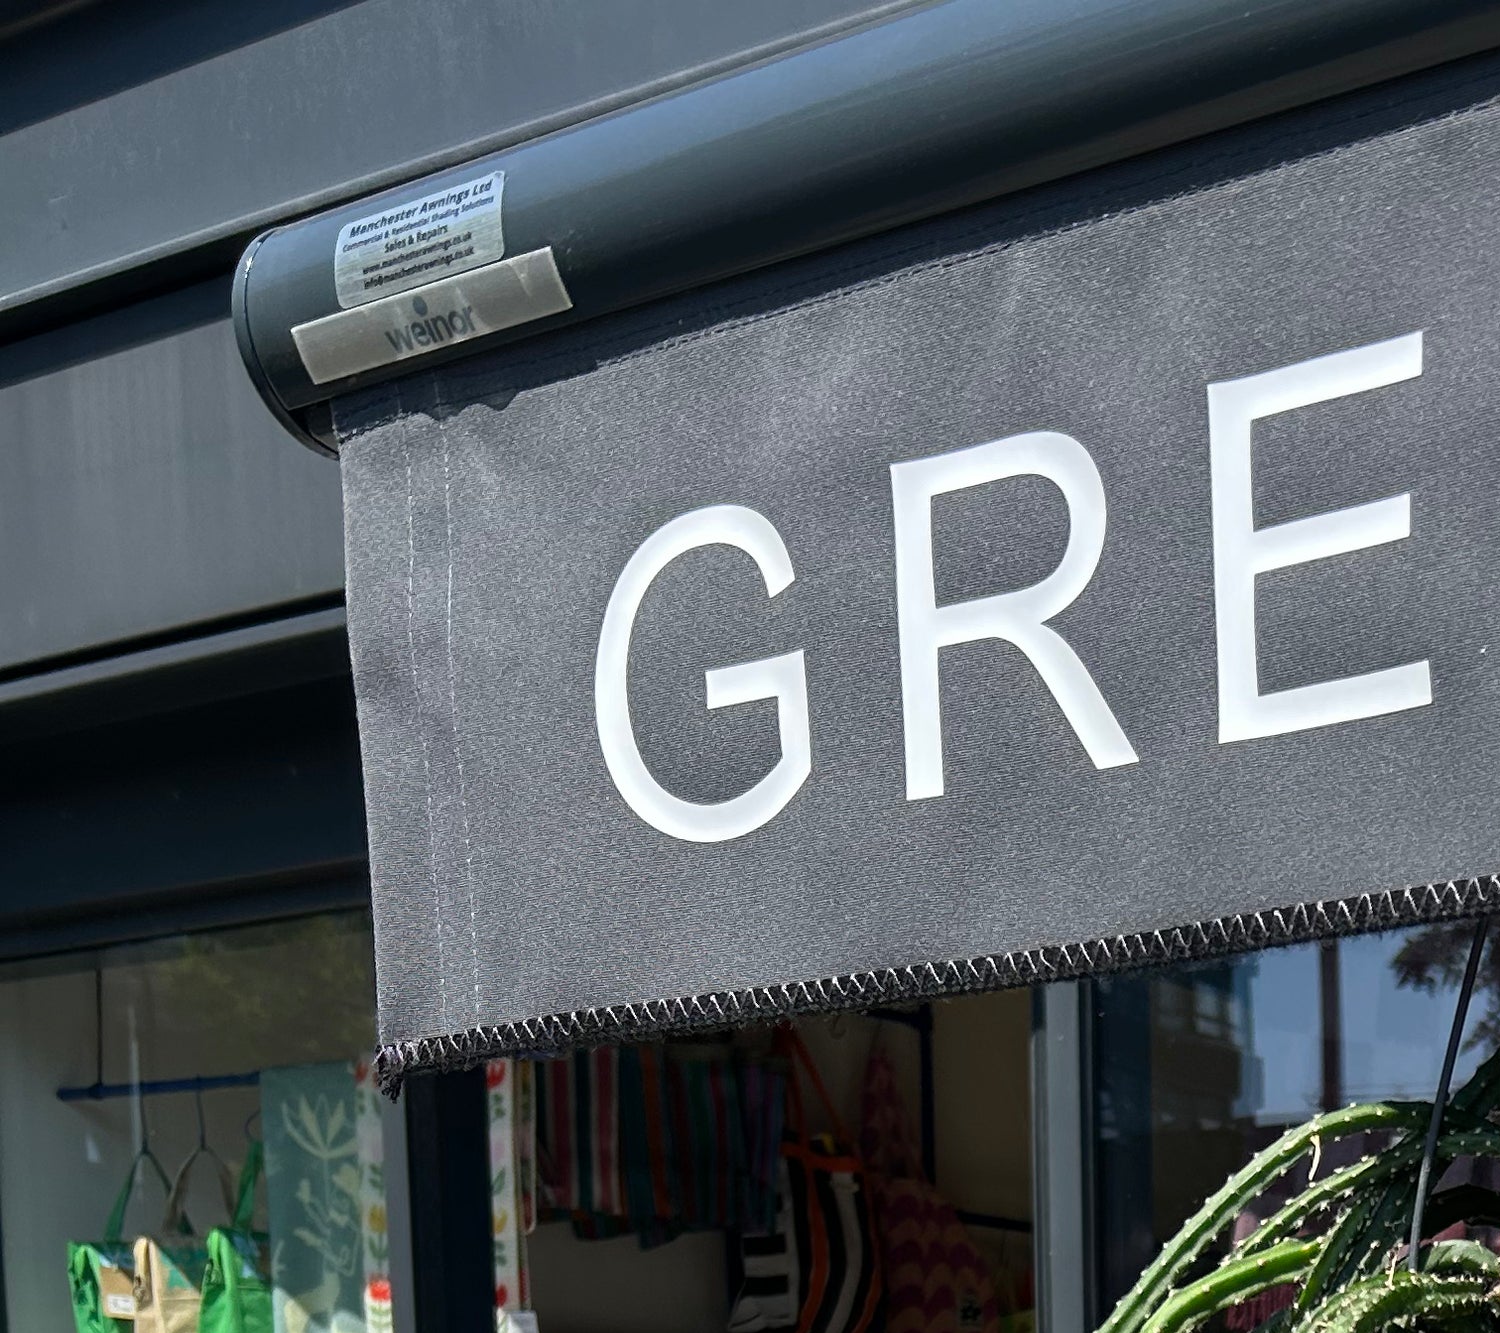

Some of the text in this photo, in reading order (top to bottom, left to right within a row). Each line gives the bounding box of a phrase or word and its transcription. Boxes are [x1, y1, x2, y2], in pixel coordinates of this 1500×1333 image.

[349, 178, 493, 238] Manchester Awnings Ltd
[384, 238, 406, 253] Sales
[416, 223, 448, 243] Repairs
[385, 296, 476, 354] weinor
